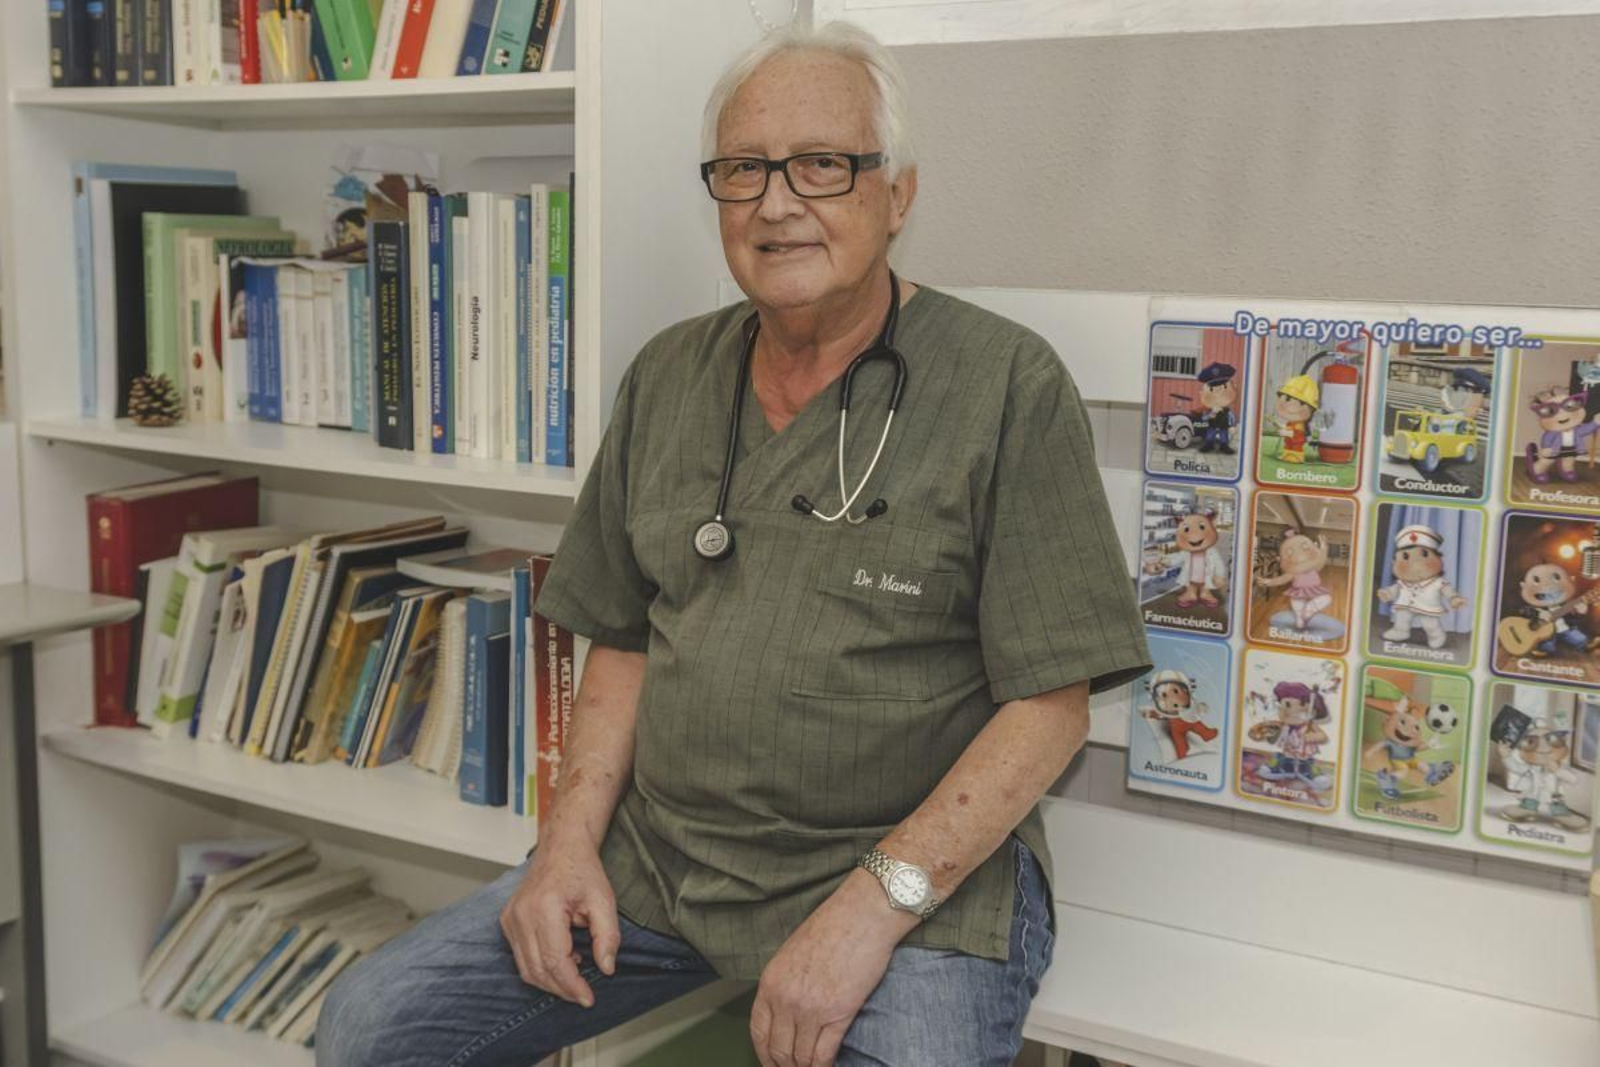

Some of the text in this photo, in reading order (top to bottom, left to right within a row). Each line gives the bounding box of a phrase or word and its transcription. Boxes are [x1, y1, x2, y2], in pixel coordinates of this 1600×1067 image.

[470, 296, 482, 361] Neurología
[1236, 312, 1543, 349] De mayor quiero ser...
[548, 285, 562, 426] nutrición en pediatría
[1276, 467, 1338, 484] Bombero
[1394, 478, 1470, 496] Conductor
[1530, 488, 1600, 505] Profesora
[853, 568, 873, 588] Dr.
[1144, 610, 1224, 631] Farmacéutica
[1268, 627, 1324, 644] Bailarina
[1383, 641, 1455, 661] Enfermera
[1517, 658, 1585, 678] Cantante
[1144, 760, 1209, 781] Astronauta
[1263, 781, 1308, 800] Pintora
[1507, 823, 1565, 844] Pediatra
